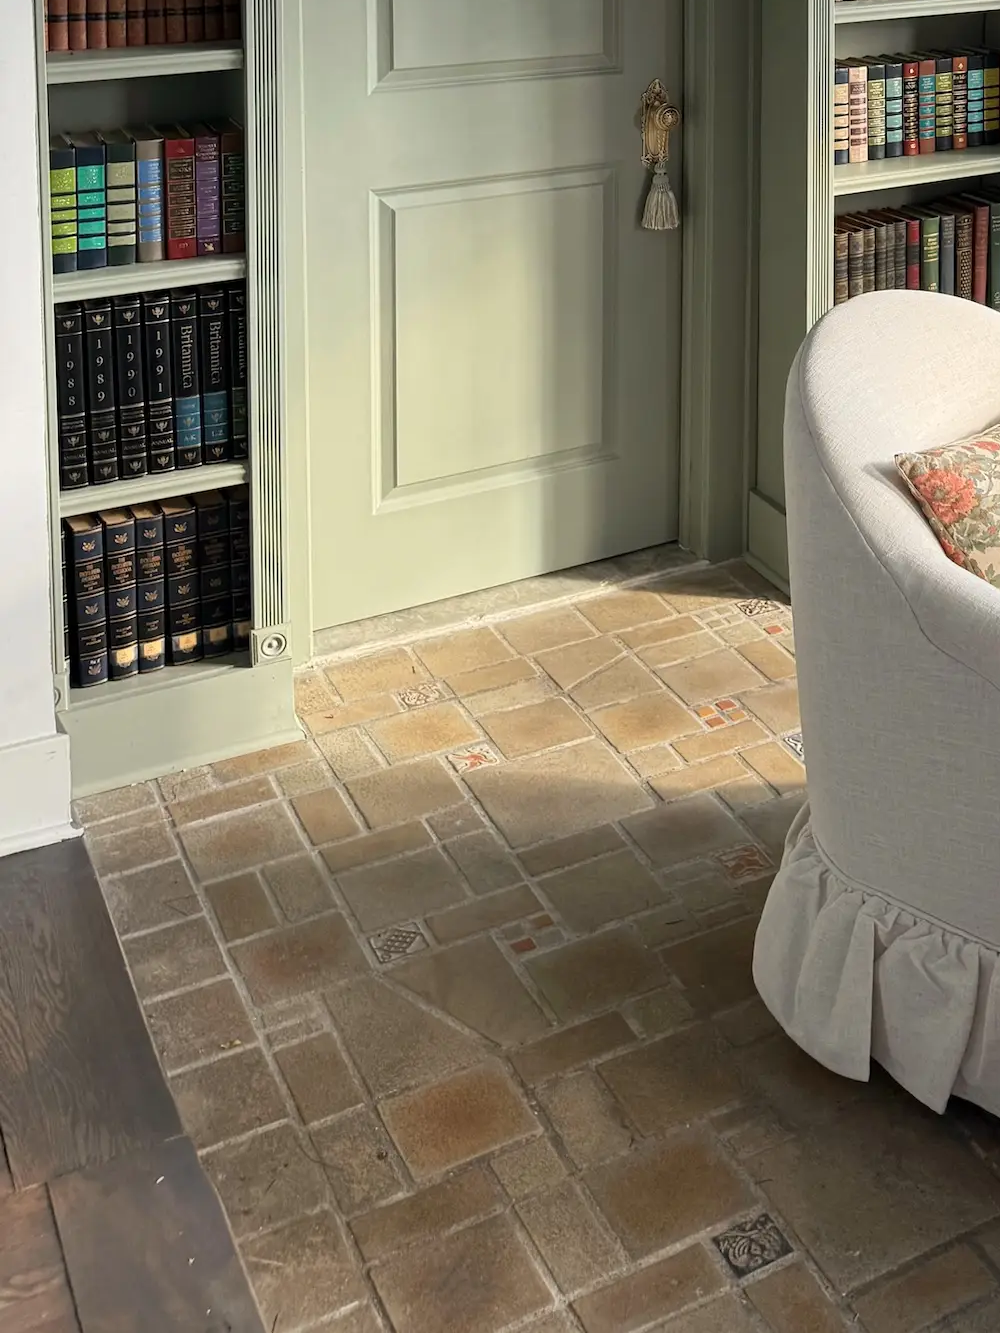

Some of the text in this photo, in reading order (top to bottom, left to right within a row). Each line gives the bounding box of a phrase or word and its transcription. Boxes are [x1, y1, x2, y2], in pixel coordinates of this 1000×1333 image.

[66, 343, 76, 406] 1988
[95, 339, 105, 402] 1989
[126, 334, 137, 397] 1990
[155, 331, 164, 393] 1991
[179, 325, 195, 389] Britannica
[209, 321, 224, 385] Britannica
[151, 438, 173, 447] ANNUAL
